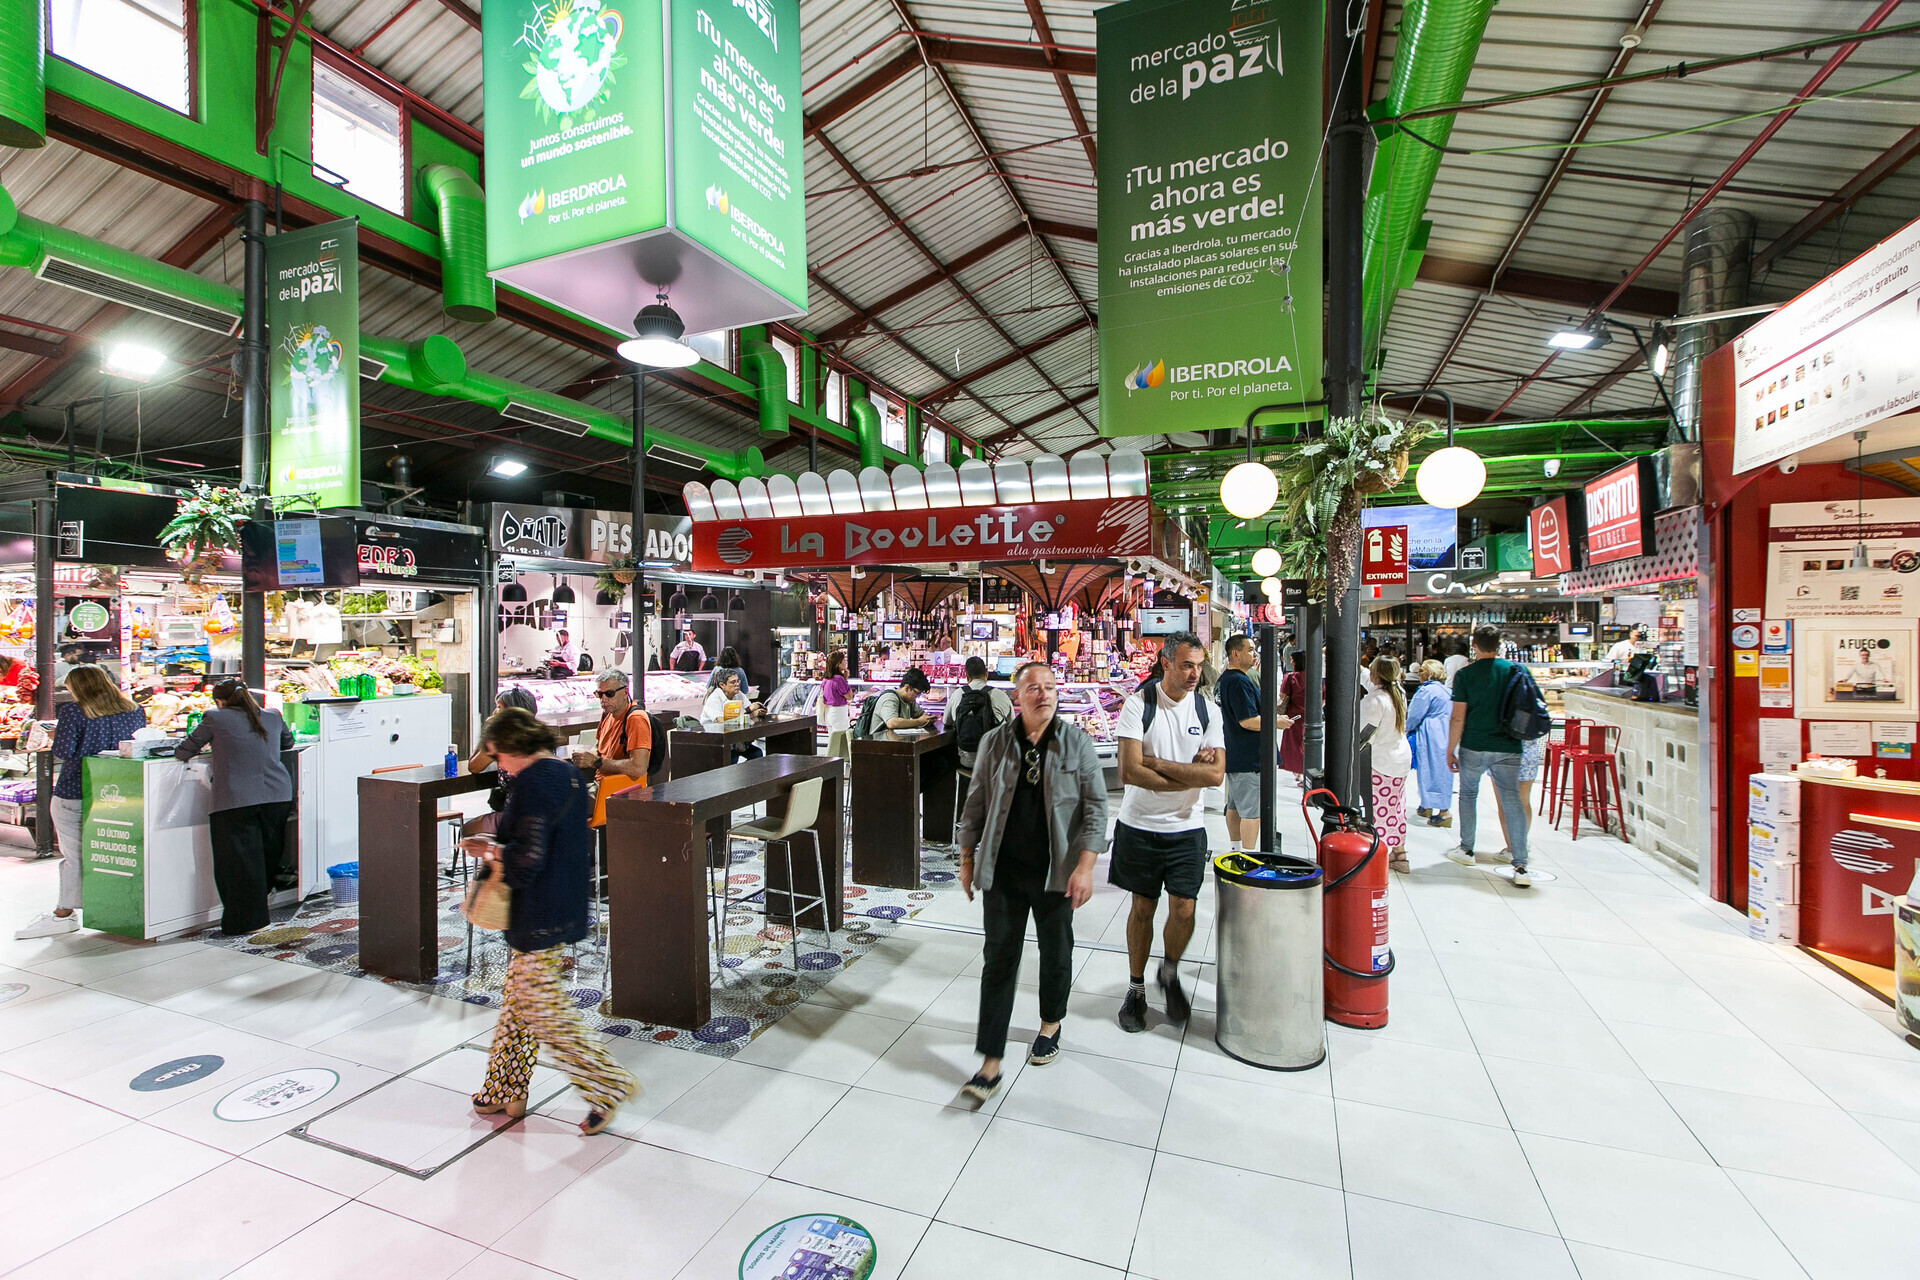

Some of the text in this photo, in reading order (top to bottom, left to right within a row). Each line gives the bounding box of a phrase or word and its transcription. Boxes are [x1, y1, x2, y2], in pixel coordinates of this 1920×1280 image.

[697, 9, 785, 113] ¡Tu mercado
[1130, 33, 1227, 72] mercado
[713, 54, 774, 125] ahora es
[1130, 44, 1264, 104] de la paz
[700, 66, 785, 160] más verde!
[520, 124, 634, 168] un mundo sostenible.
[529, 112, 624, 155] Juntos construimos
[696, 92, 722, 121] Gracias
[764, 153, 789, 180] mercado
[703, 110, 734, 144] instalado
[734, 139, 754, 162] placas
[754, 157, 775, 179] solares
[701, 121, 743, 165] instalaciones
[743, 160, 758, 177] para
[758, 172, 778, 194] reducir
[719, 152, 751, 184] emisiones
[1126, 138, 1289, 193] ¡Tu mercado
[547, 174, 627, 210] IBERDROLA
[1150, 173, 1262, 211] ahora es
[548, 196, 628, 225] Por ti. Por el planeta.
[1130, 193, 1285, 242] más verde!
[730, 203, 786, 257] IBERDROLA
[730, 223, 742, 239] Por
[748, 236, 759, 250] Por
[765, 249, 787, 271] planeta.
[1124, 226, 1292, 264] Gracias a Iberdrola, tu mercado
[279, 262, 320, 281] mercado
[1118, 240, 1298, 277] ha instalado placas solares en sus
[1129, 255, 1286, 288] instalaciones para reducir las
[279, 272, 334, 303] de la paz
[1156, 273, 1255, 297] emisiones de CO2.
[1868, 285, 1875, 297] y
[1875, 264, 1910, 293] gratuito
[1170, 355, 1293, 384] IBERDROLA
[1170, 380, 1293, 401] Por ti. Por el planeta.
[1865, 390, 1920, 418] www.laboule
[1585, 473, 1638, 529] DISTRITO
[591, 518, 693, 563] PESADO
[1006, 543, 1105, 560] alta gastronomía
[1596, 527, 1627, 548] BURGER
[1366, 572, 1404, 580] EXTINTOR
[1838, 639, 1846, 649] A
[90, 840, 137, 855] EN PULIDOR DE
[97, 827, 130, 840] LO ÚLTIMO
[90, 853, 137, 868] JOYAS Y VIDRIO
[763, 1243, 772, 1253] DE
